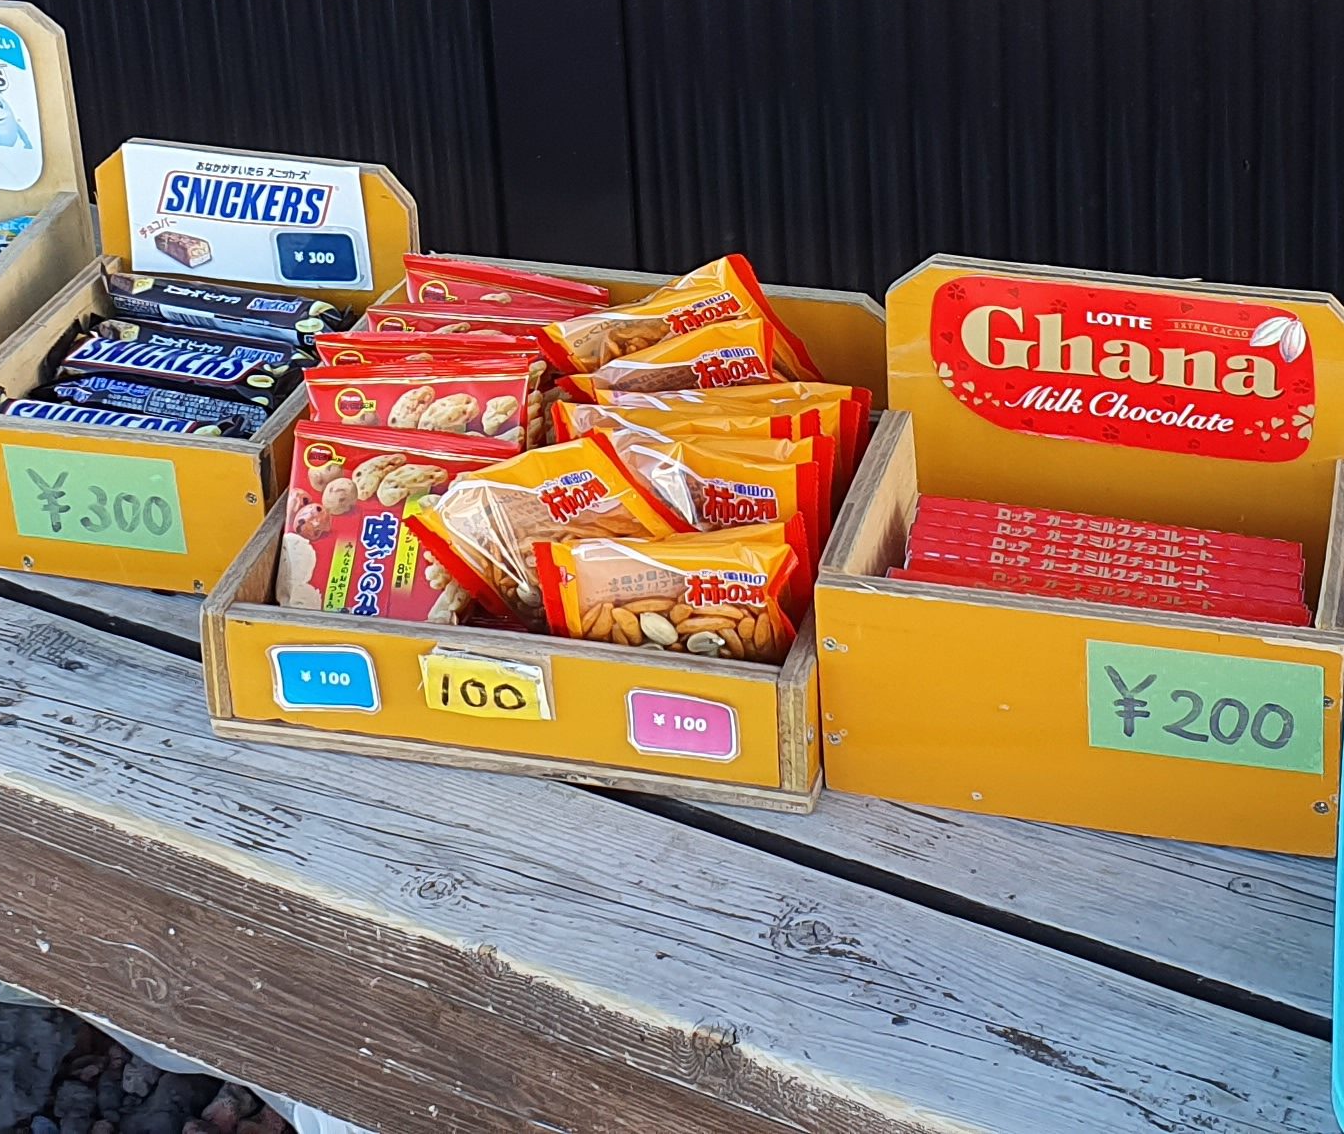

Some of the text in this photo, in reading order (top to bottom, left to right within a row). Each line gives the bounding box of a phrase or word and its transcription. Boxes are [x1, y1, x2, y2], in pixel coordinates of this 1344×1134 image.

[196, 162, 263, 176] おなかがすいたら
[166, 175, 324, 225] SNICKERS
[295, 252, 335, 264] ¥ 300
[1086, 311, 1152, 330] LOTTE
[961, 305, 1284, 399] Ghana
[1005, 386, 1233, 433] Milk Chocolate
[26, 467, 173, 534] ¥300
[998, 508, 1212, 546] ロッテ ガーナミルクチョコレート
[998, 522, 1213, 561] ロッテ ガーナミルクチョコレート
[990, 552, 1210, 591] ロッテ ガーナミルクチョコレート
[992, 537, 1211, 576] ロッテ ガーナミルクチョコレート
[319, 671, 351, 687] 100
[439, 671, 526, 711] 100
[673, 714, 707, 733] 100
[1103, 665, 1295, 750] ¥200
